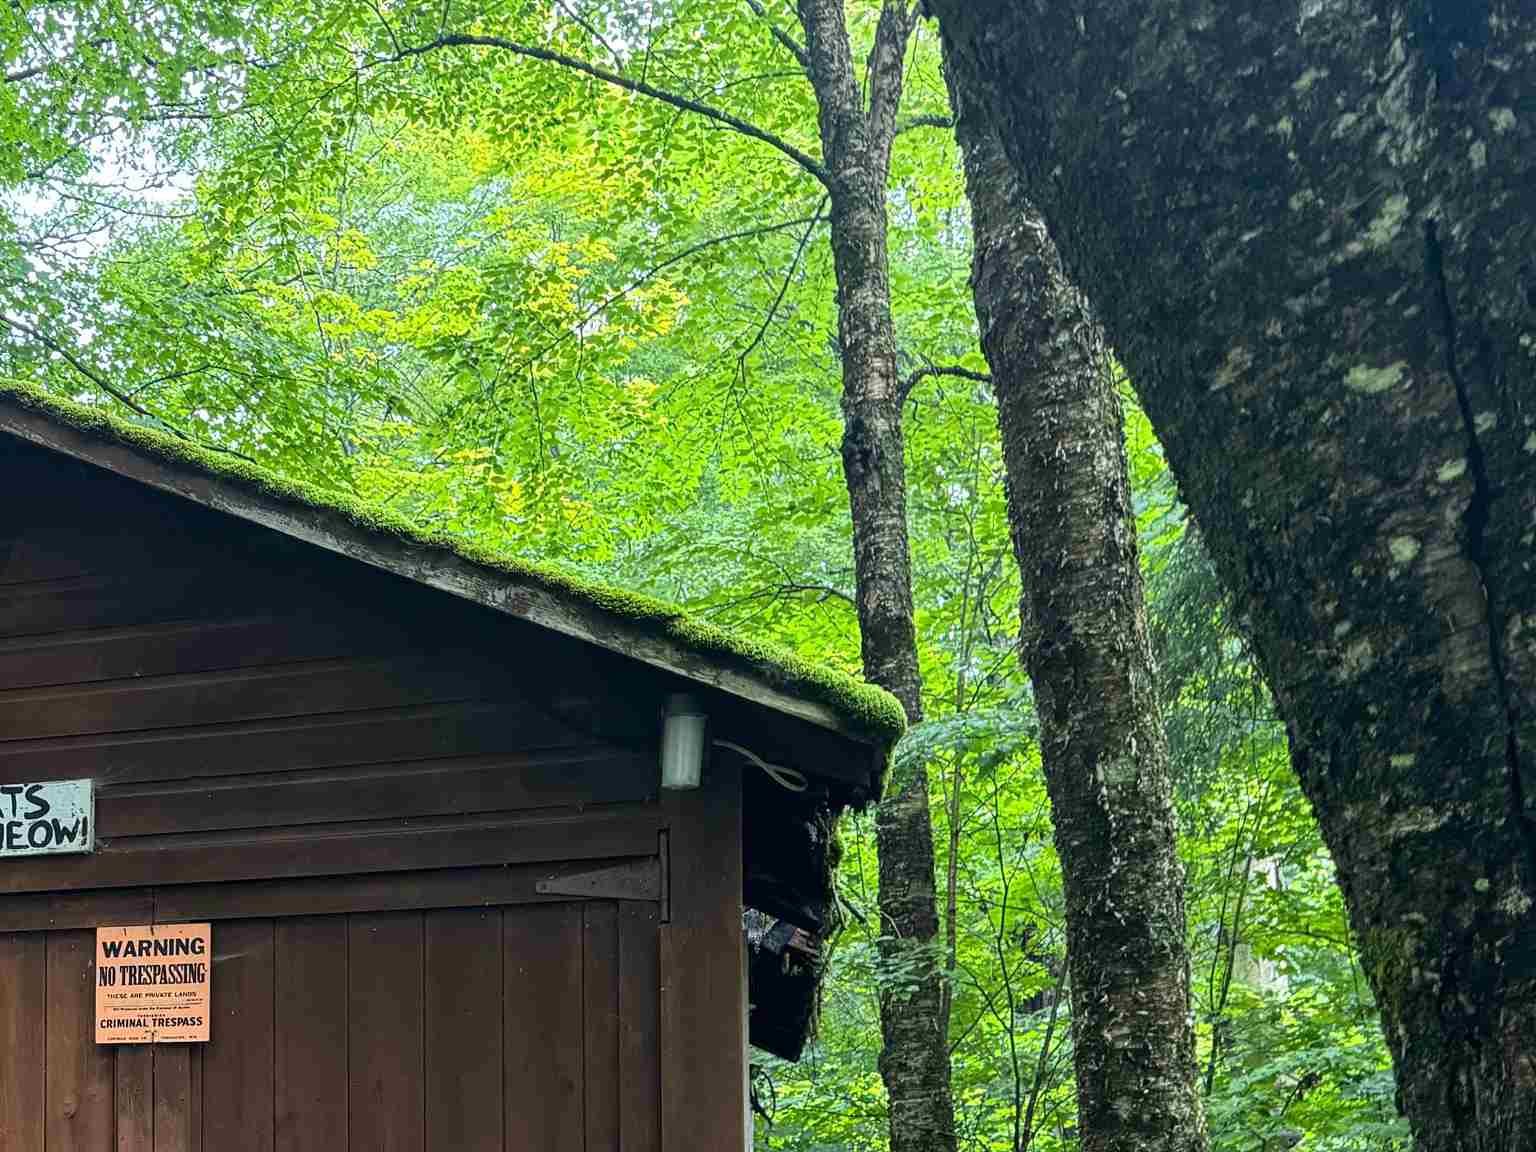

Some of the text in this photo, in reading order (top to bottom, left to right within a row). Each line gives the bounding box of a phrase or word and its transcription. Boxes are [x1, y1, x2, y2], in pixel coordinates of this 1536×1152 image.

[102, 937, 205, 958] WARNING
[99, 962, 206, 986] NO TRESPASSING
[100, 1016, 203, 1029] CRIMINAL TRESPASS
